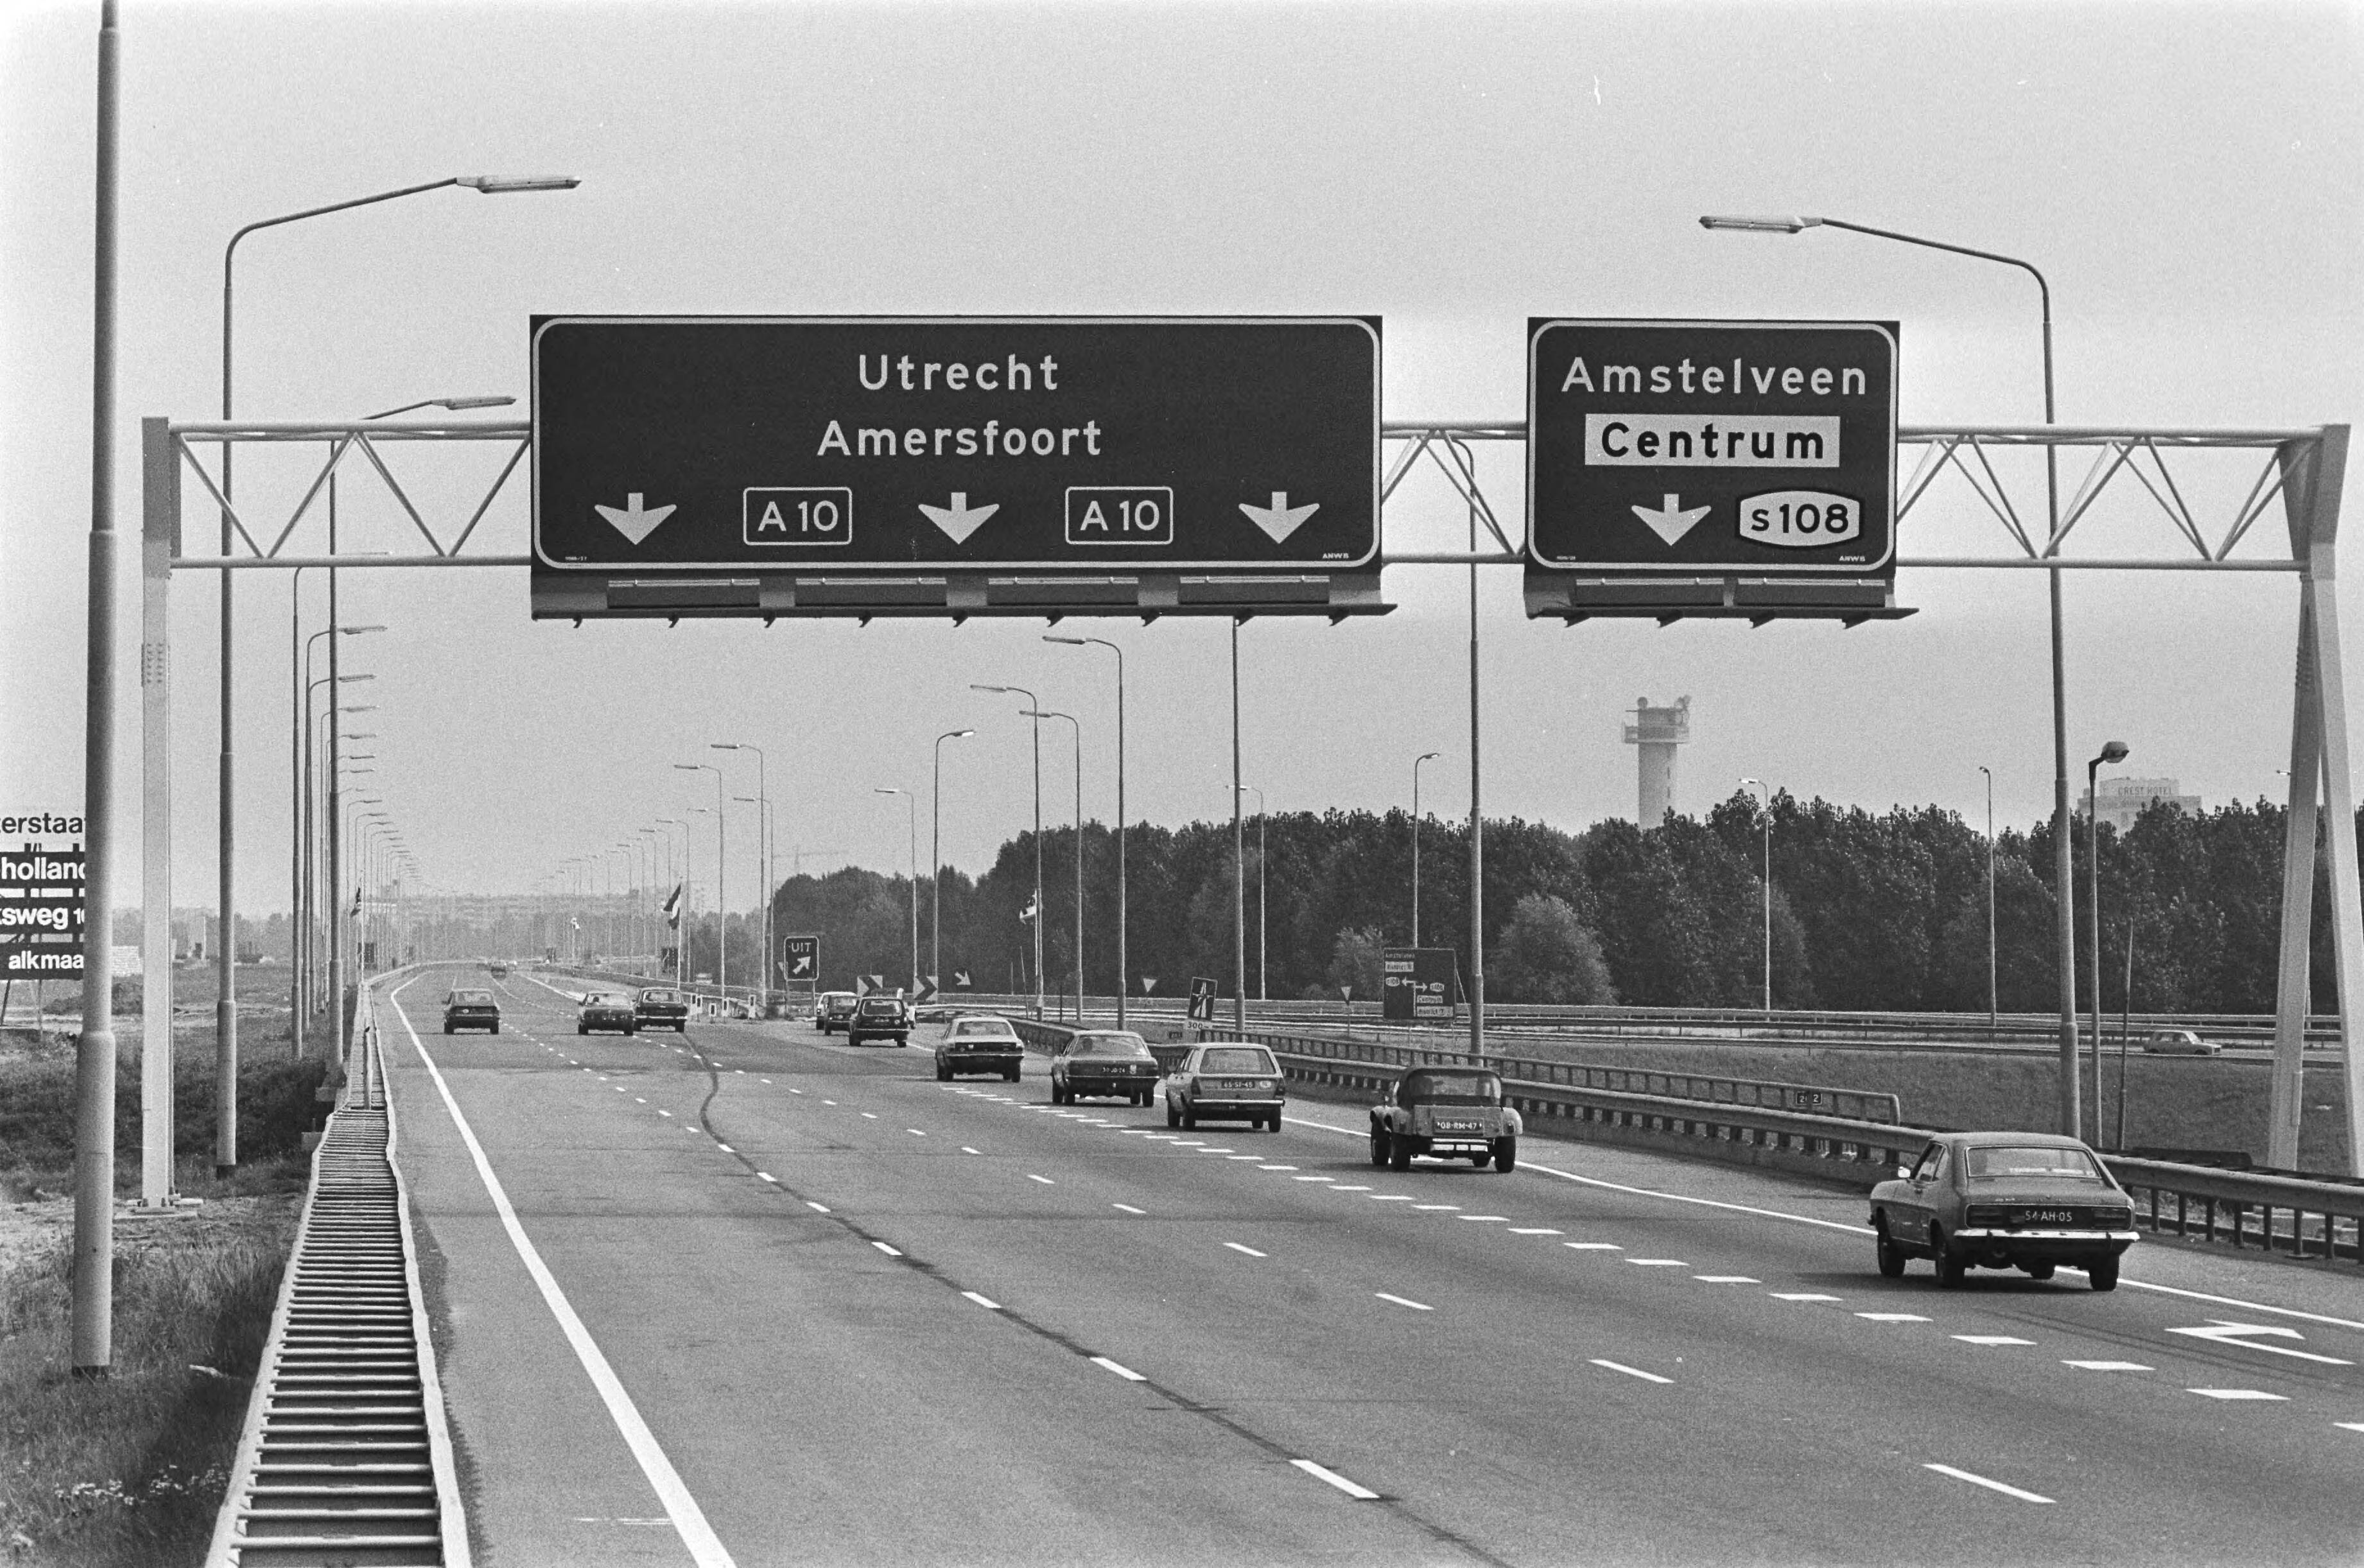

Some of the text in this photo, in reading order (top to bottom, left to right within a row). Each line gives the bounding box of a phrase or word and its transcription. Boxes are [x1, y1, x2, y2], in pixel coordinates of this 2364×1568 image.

[859, 353, 1058, 390] Utrecht
[1561, 356, 1866, 395] Amstelveen
[817, 420, 1101, 456] Amersfoort
[1601, 422, 1823, 459] Centrum
[758, 500, 839, 532] A 10
[1080, 500, 1160, 531] A 10
[0, 813, 86, 833] erstaa
[0, 907, 68, 930] sweg
[791, 942, 812, 953] UIT
